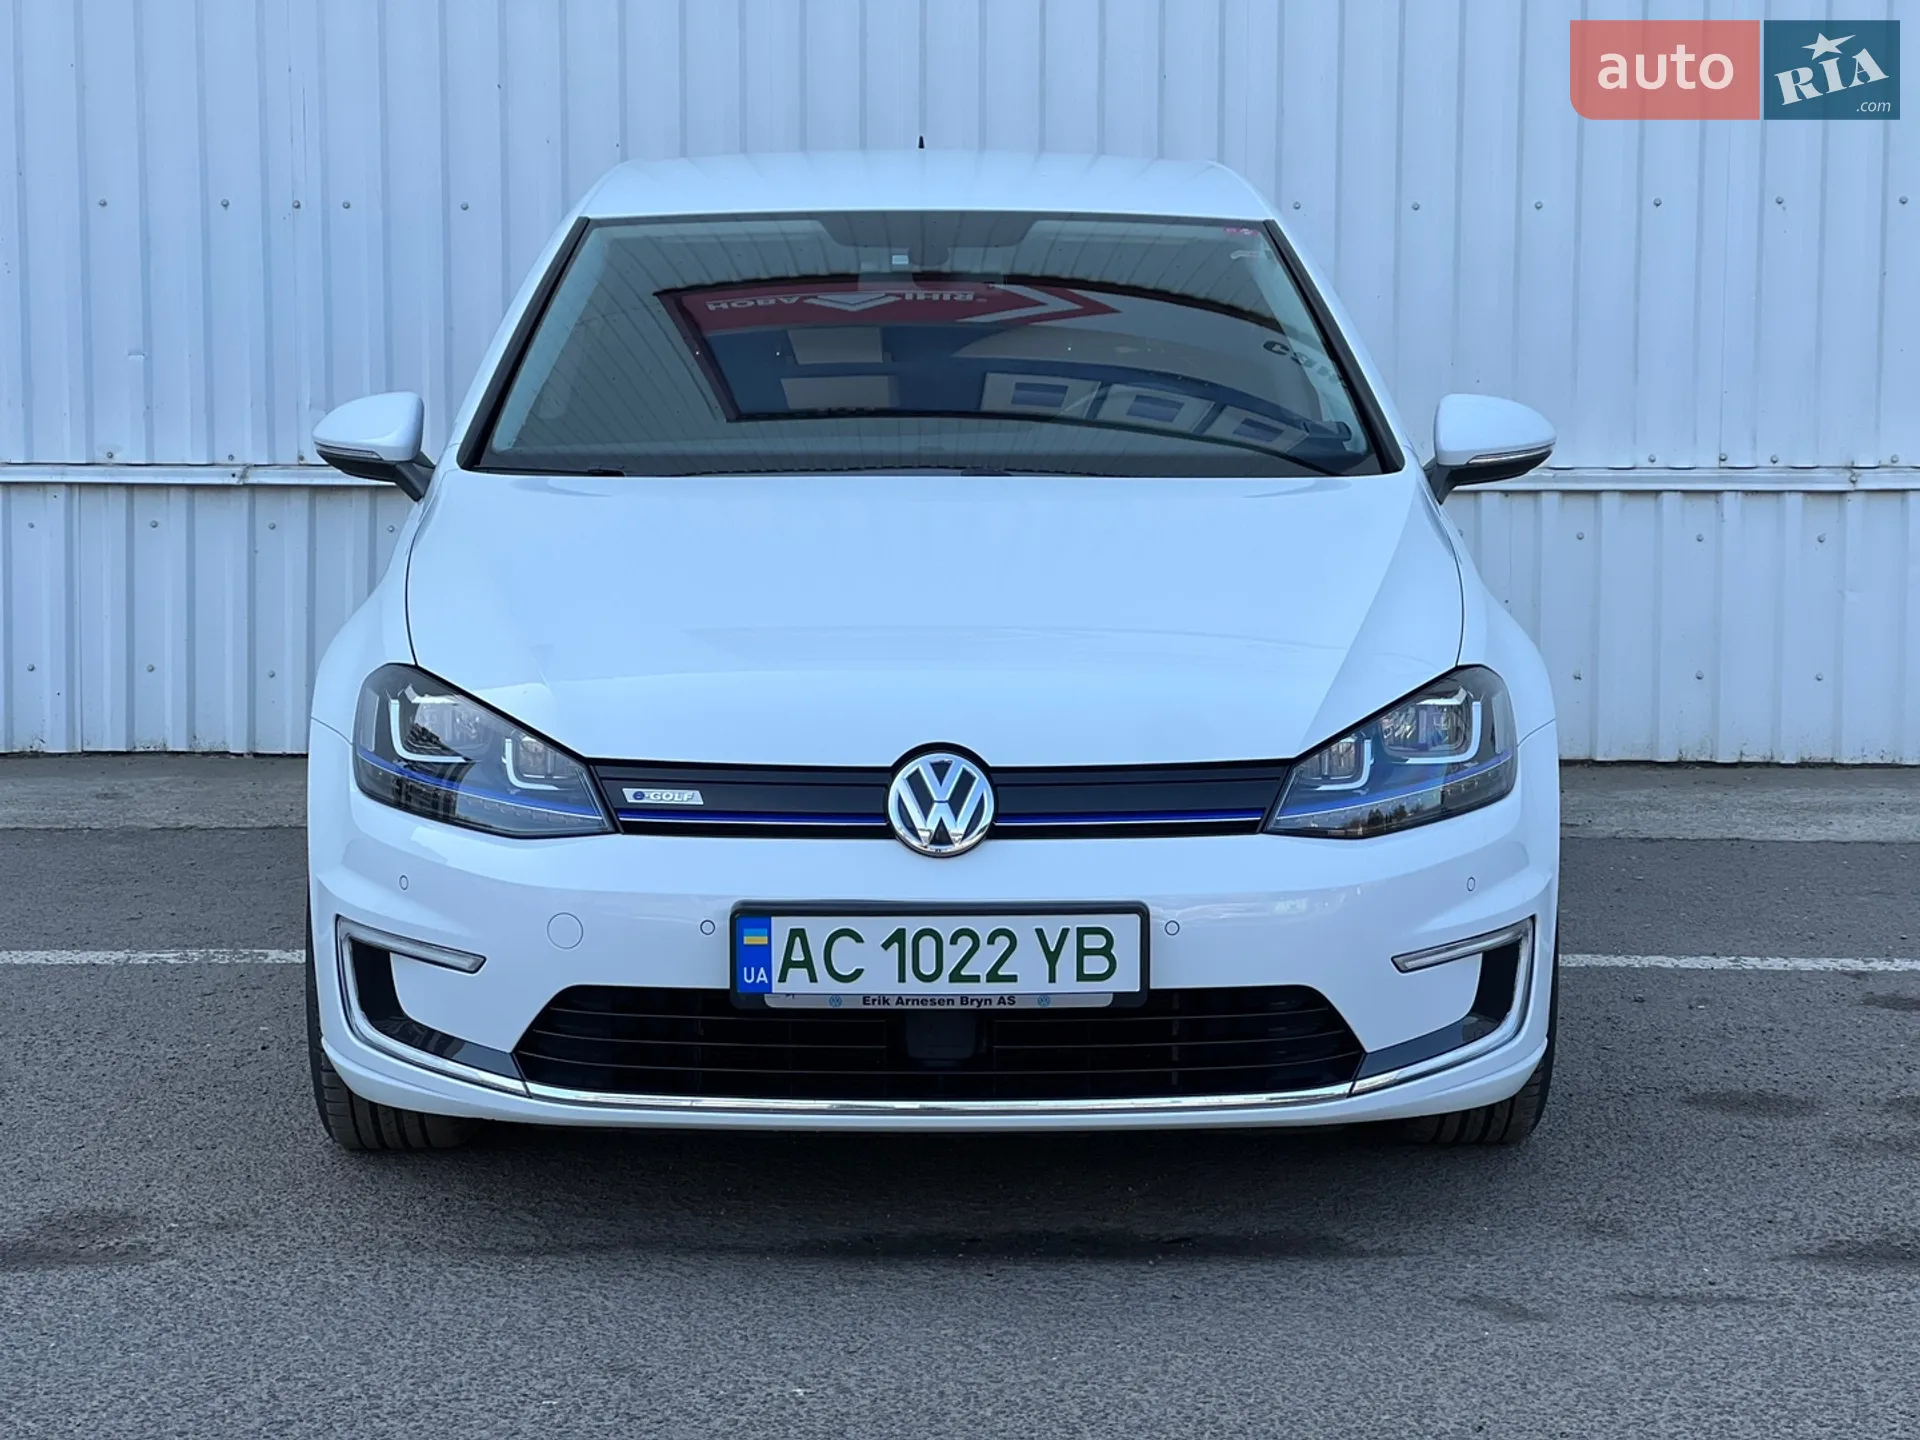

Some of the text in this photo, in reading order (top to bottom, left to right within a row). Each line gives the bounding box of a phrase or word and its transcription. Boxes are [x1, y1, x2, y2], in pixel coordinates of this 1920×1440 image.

[777, 927, 1118, 984] AC 1022 YB
[743, 966, 769, 985] UA
[862, 995, 1016, 1008] Erik Arnesen Bryn AS
